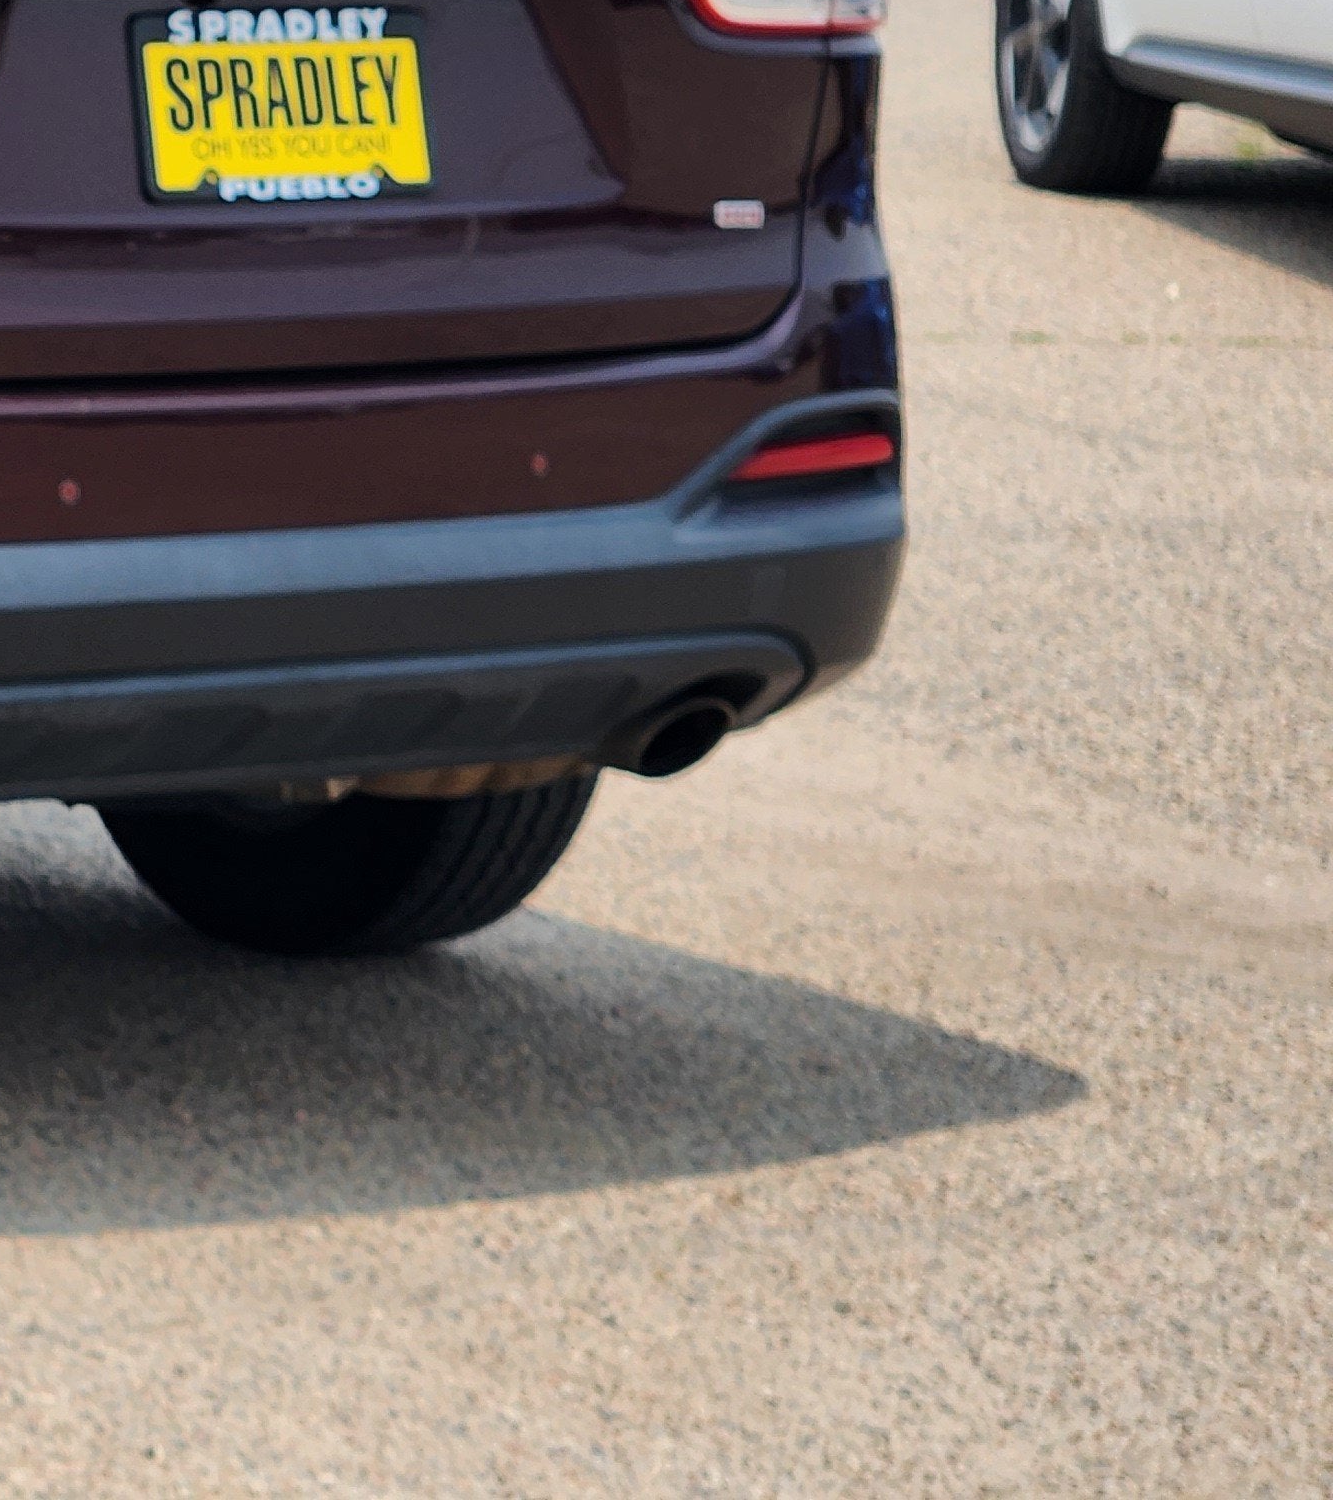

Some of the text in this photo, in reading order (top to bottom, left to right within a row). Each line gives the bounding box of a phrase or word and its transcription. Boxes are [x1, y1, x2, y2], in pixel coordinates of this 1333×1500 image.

[167, 7, 388, 43] SPRADLEY
[165, 54, 398, 131] SPRADLEY
[191, 137, 231, 160] OH
[281, 134, 331, 158] YOU
[218, 175, 381, 202] PUEBLO
